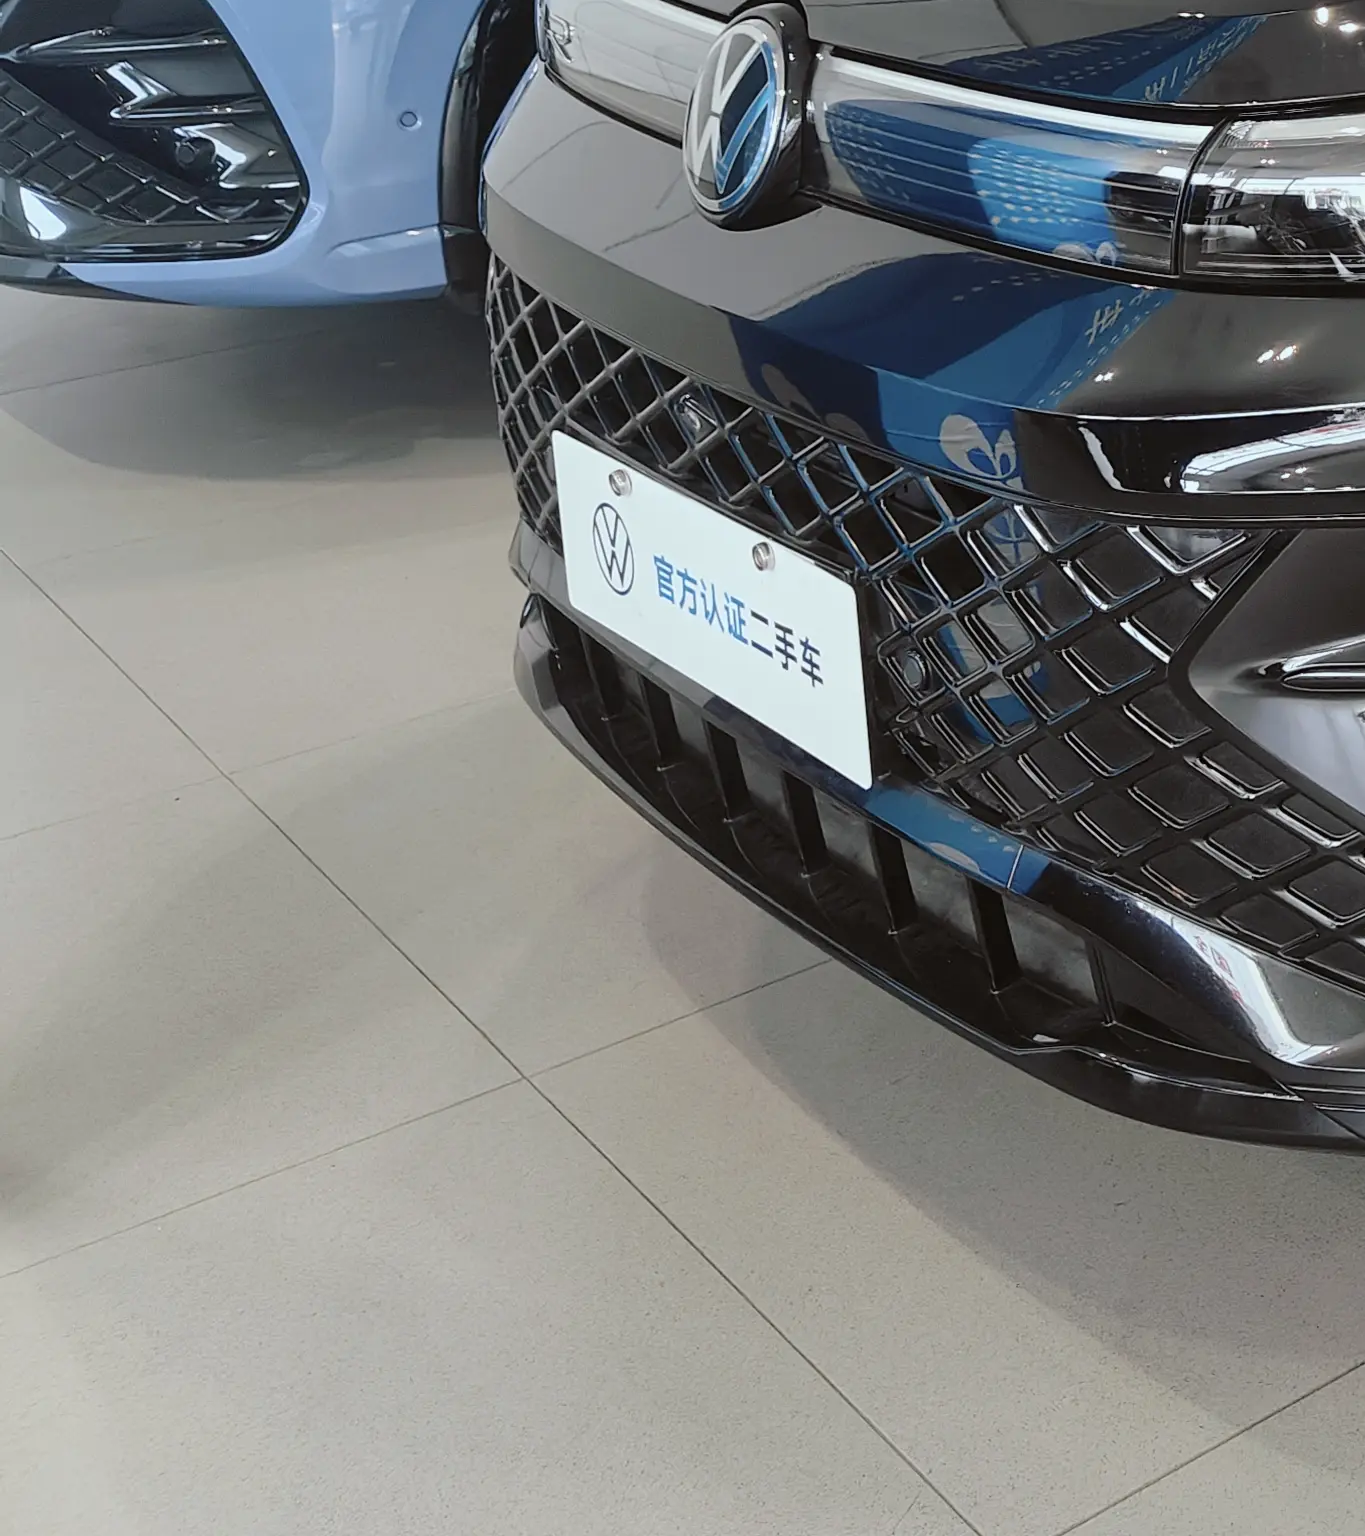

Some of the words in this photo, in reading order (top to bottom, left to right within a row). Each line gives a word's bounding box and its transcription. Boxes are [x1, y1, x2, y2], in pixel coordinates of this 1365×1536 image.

[653, 554, 824, 688] 官方认证二手车
